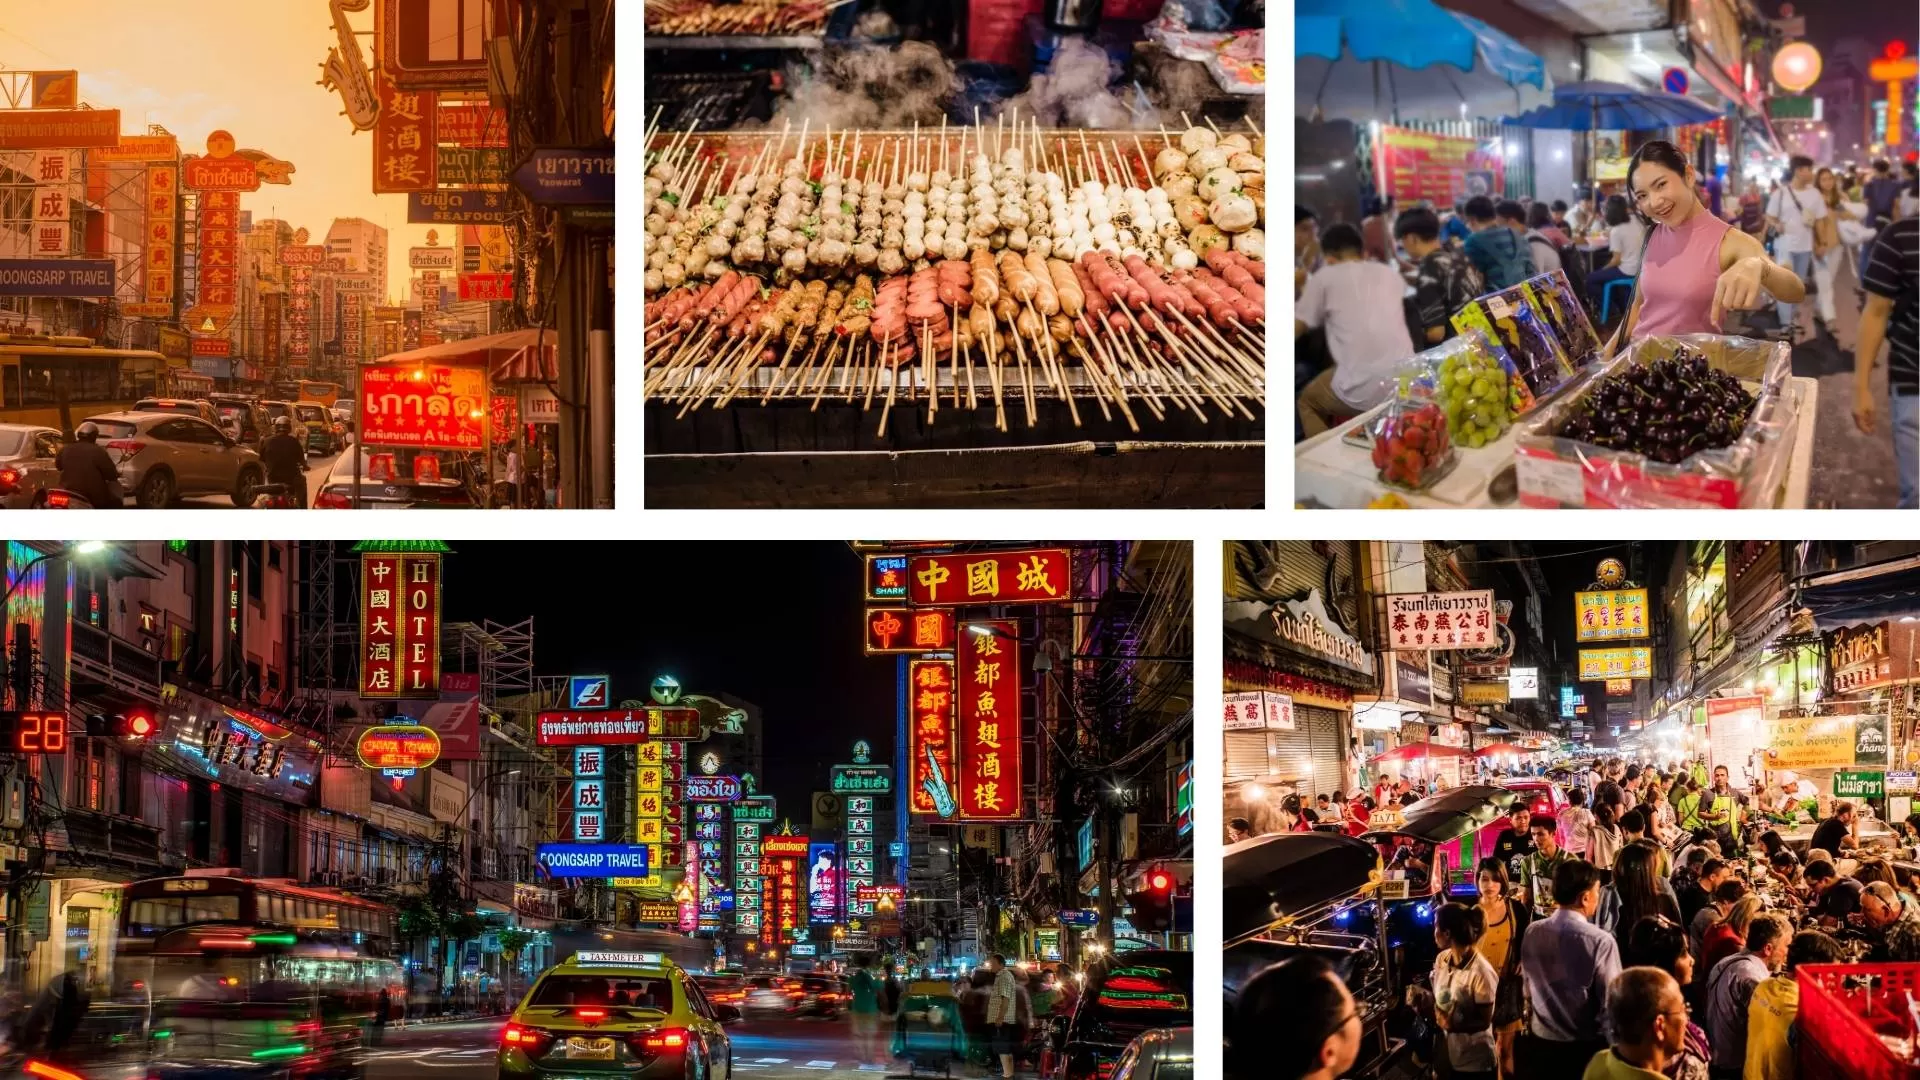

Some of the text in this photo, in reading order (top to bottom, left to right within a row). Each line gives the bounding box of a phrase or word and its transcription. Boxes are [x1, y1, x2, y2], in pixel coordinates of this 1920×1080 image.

[439, 128, 478, 138] HARK
[539, 178, 582, 187] Yaowarat
[39, 156, 63, 252] 振成豐
[433, 211, 504, 221] SEAFOOD
[70, 270, 111, 286] TRAVEL
[366, 386, 477, 416] เกาลัด
[424, 429, 436, 441] A
[916, 555, 1057, 602] 中國城
[876, 587, 906, 595] SHARK
[368, 561, 393, 689] 中國大酒店
[412, 563, 429, 689] HOTEL
[872, 611, 944, 649] 中國
[1391, 610, 1490, 632] 泰南燕公司
[22, 716, 65, 751] 28
[541, 712, 645, 743] รุ่งทรัพย์การท่องเที่ยว
[972, 633, 1004, 812] 銀都魚翅酒樓
[1855, 743, 1887, 753] Chang
[578, 751, 601, 838] 振成豐
[1835, 774, 1882, 794] ไม่มีสาขา
[606, 853, 645, 868] TRAVEL
[1089, 913, 1096, 921] 2
